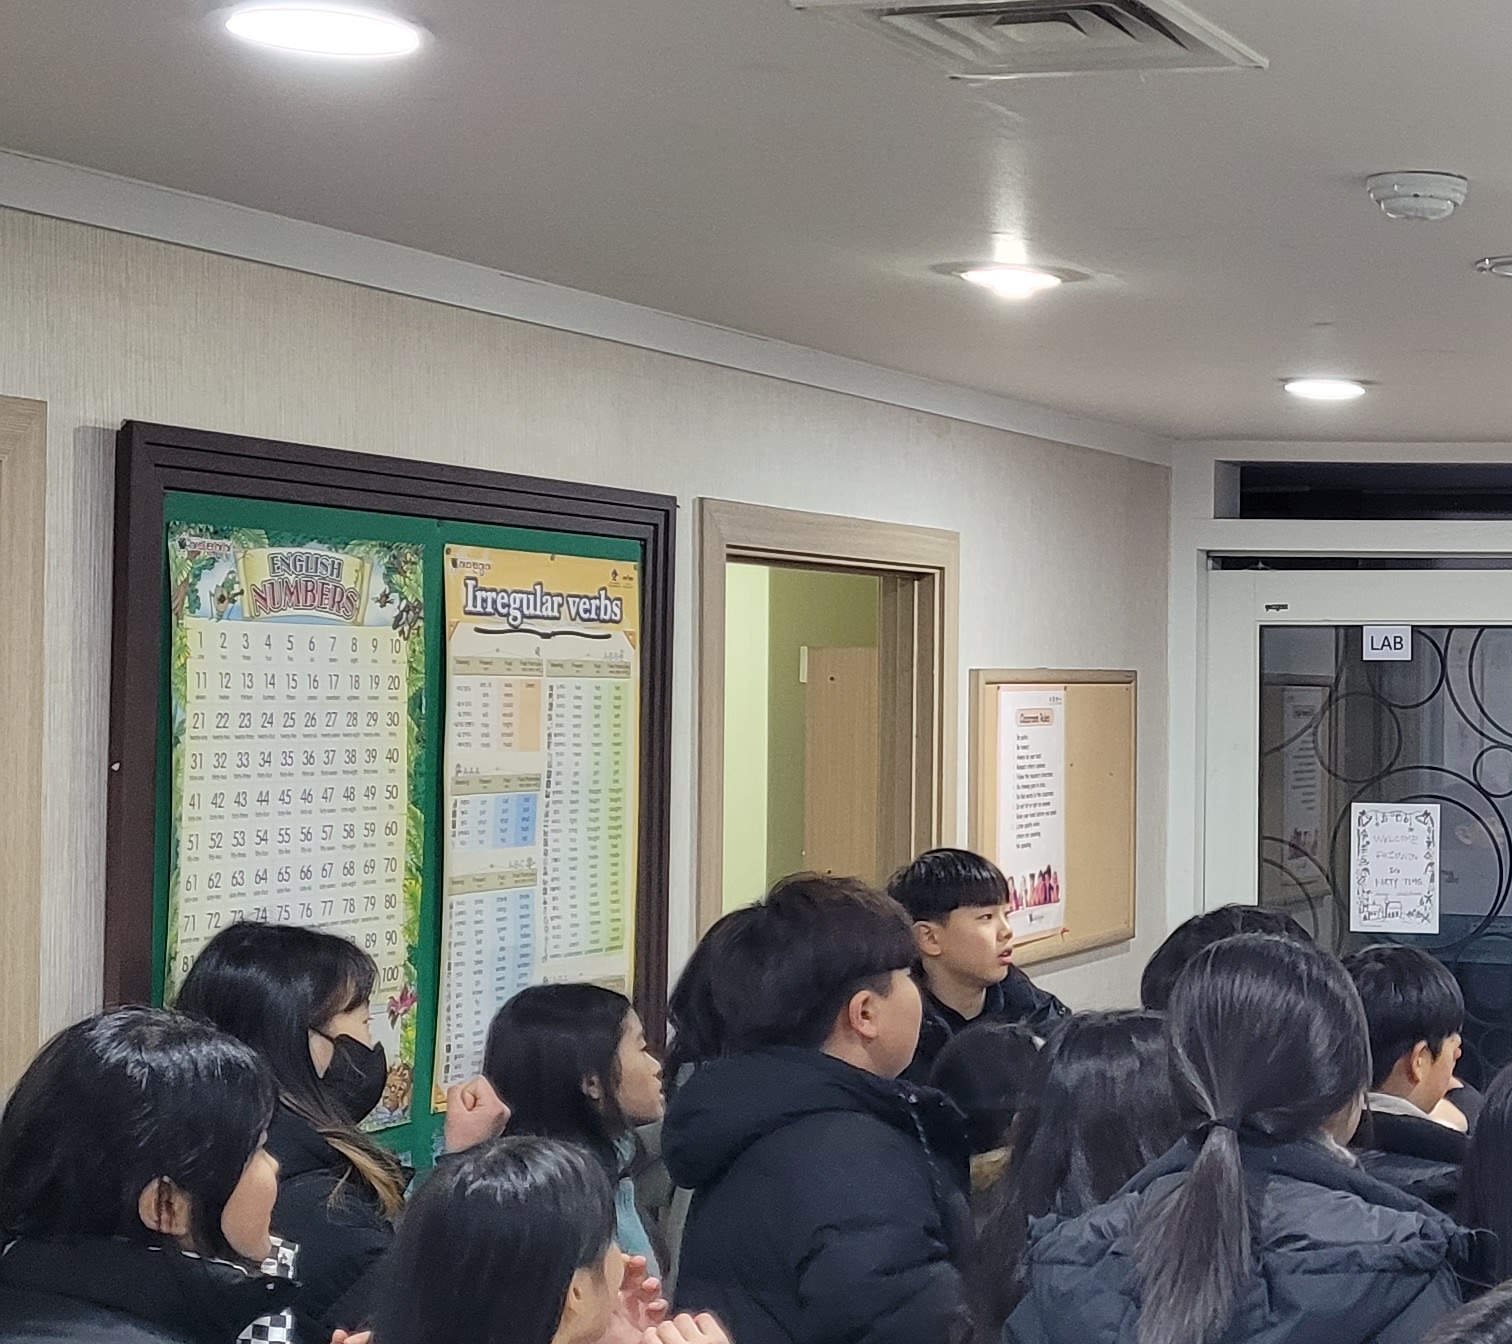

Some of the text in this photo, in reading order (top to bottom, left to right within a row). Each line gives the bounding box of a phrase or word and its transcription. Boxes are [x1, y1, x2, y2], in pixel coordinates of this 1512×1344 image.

[269, 552, 344, 581] ENGLISH
[250, 577, 360, 620] NUMBERS
[464, 576, 623, 629] Irregular verbs
[197, 630, 401, 655] 1 2 3 4 5 6 7 8 9 10
[1370, 635, 1404, 651] LAB
[195, 671, 401, 691] 11 12 13 14 15 16 17 18 19 20
[191, 711, 400, 730] 21 22 23 24 25 26 27 28 29 30
[190, 747, 400, 770] 31 32 33 34 35 36 37 38 39 40
[188, 784, 399, 811] 41 42 43 44 45 46 47 48 49 50
[186, 820, 398, 852] 51 52 53 54 55 56 57 58 59 60
[185, 856, 398, 892] 61 62 63 64 65 66 67 68 69 70
[183, 914, 196, 933] 71
[206, 911, 222, 930] 72
[253, 906, 268, 924] 74
[276, 904, 291, 922] 75
[298, 902, 313, 920] 76
[320, 899, 334, 917] 77
[342, 897, 356, 914] 78
[363, 895, 377, 912] 79
[384, 893, 397, 910] 80
[364, 932, 377, 949] 89
[385, 929, 398, 946] 90
[382, 965, 399, 983] 100
